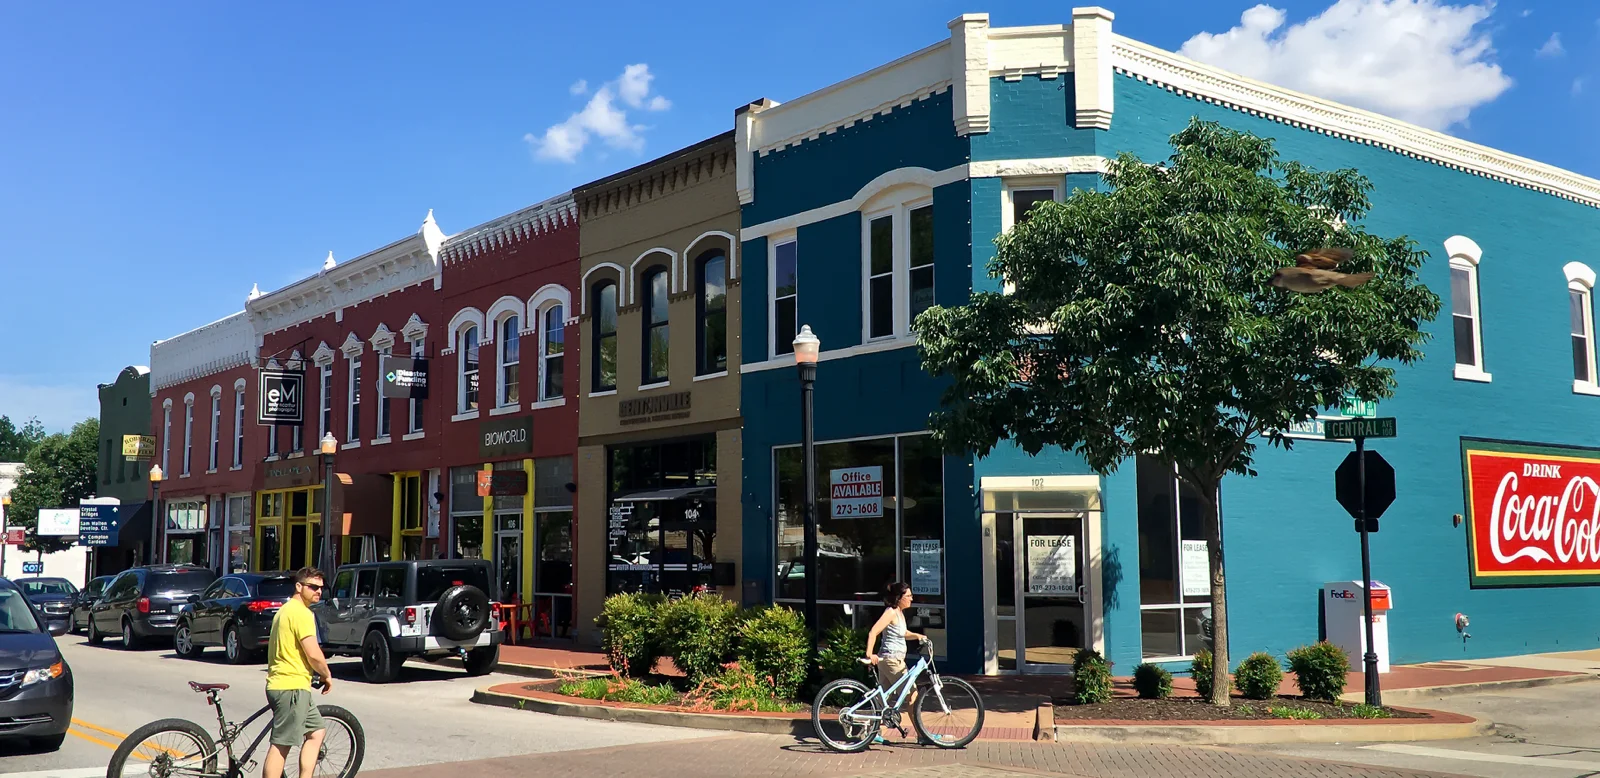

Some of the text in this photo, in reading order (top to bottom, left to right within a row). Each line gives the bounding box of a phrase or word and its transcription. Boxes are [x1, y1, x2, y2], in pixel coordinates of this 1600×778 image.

[268, 383, 295, 403] eM
[619, 392, 691, 417] BENTONVILLE
[1346, 399, 1366, 415] MAIN
[1332, 421, 1379, 437] CENTRAL
[1382, 420, 1393, 429] AVE
[1382, 428, 1393, 436] 100
[485, 429, 526, 447] BIOWORLD
[1522, 462, 1562, 479] DRINK
[841, 472, 871, 482] Office
[1031, 478, 1044, 486] 102
[833, 483, 880, 498] AVAILABLE
[836, 503, 877, 515] 273-1608
[1489, 471, 1600, 564] Coca-Col
[507, 519, 516, 529] 106
[912, 543, 922, 551] FOR
[1031, 539, 1072, 547] FOR LEASE
[1183, 543, 1193, 552] FOR
[23, 564, 43, 572] COX
[1331, 589, 1355, 599] FedEx
